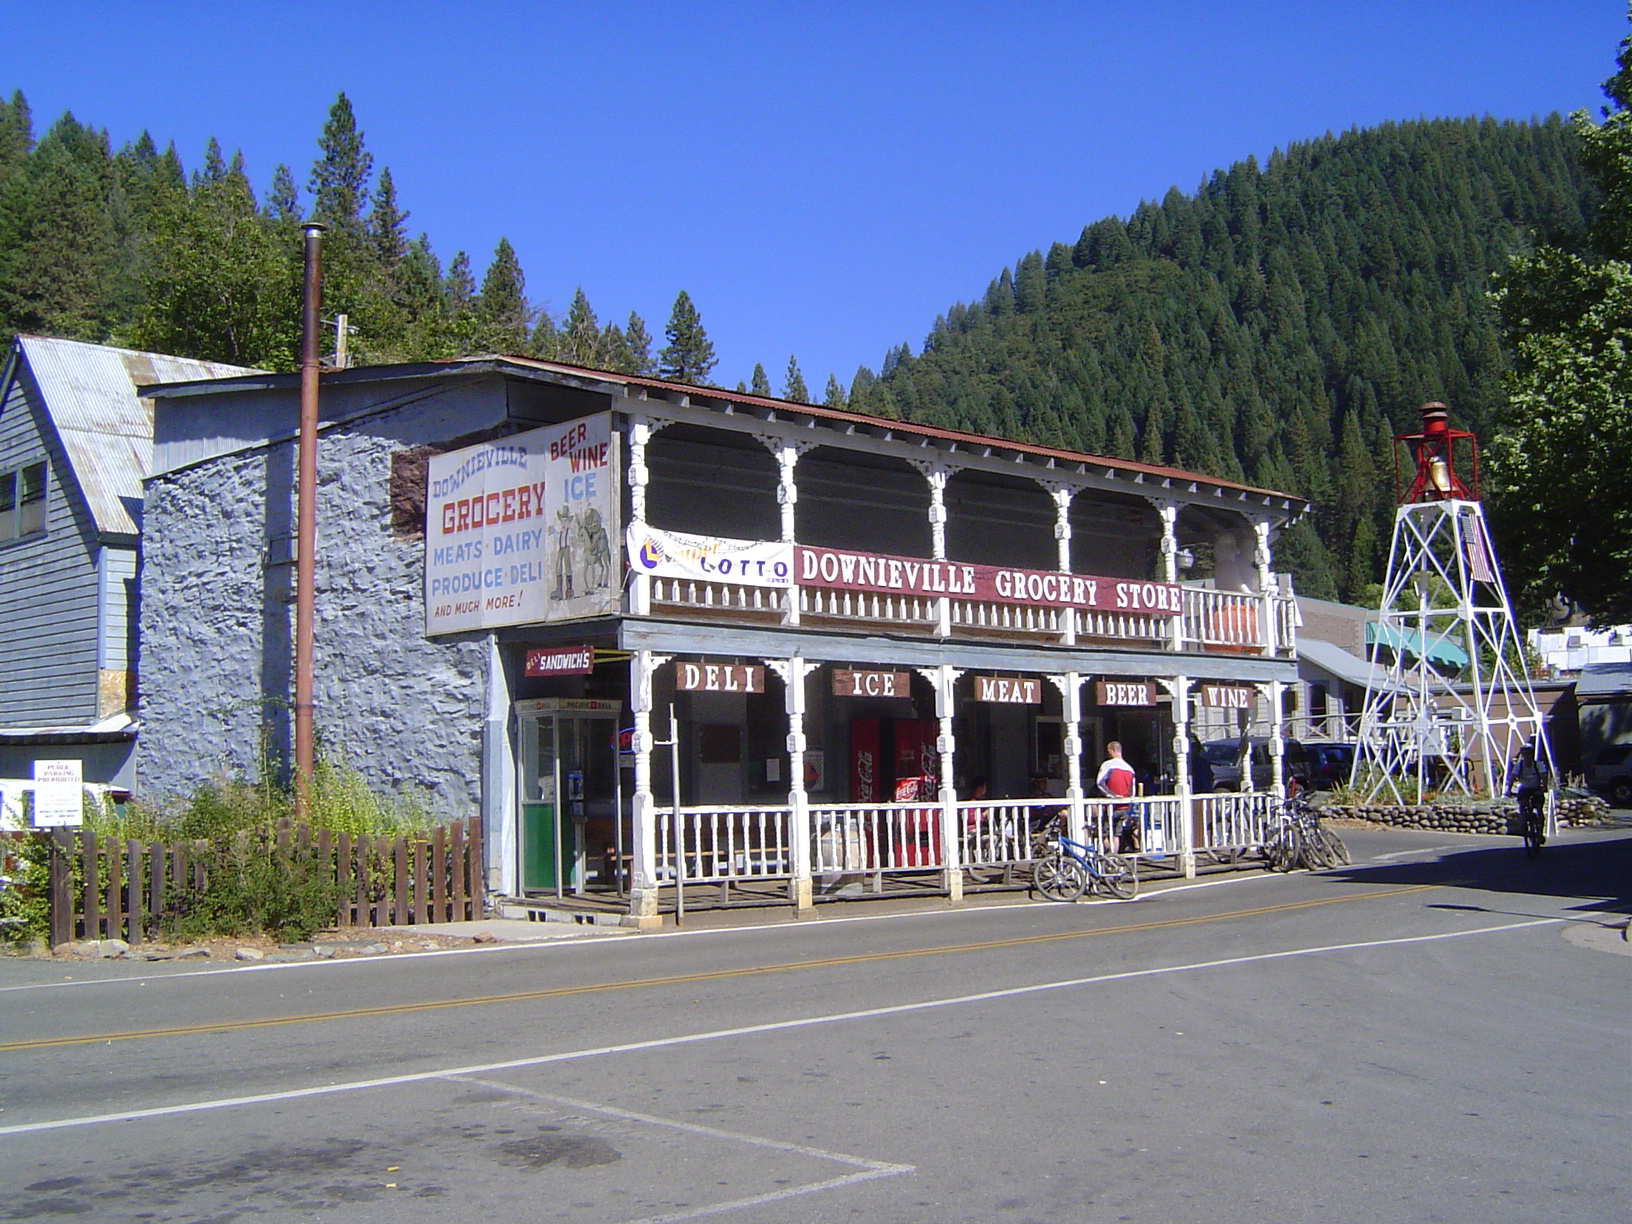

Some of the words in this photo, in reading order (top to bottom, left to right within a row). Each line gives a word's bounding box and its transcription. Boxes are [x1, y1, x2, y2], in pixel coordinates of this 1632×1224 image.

[551, 423, 587, 461] BEER
[569, 442, 608, 473] WINE
[433, 446, 528, 498] DOWNIEVILLE
[564, 472, 597, 503] ICE
[443, 481, 546, 534] GROCERY
[433, 540, 482, 567] MEATS
[494, 528, 543, 556] DAIRY
[432, 568, 502, 596] PRODUCE
[510, 561, 542, 584] DELI
[700, 556, 788, 577] LOTTO
[802, 550, 976, 594] DOWNIEVILLE
[995, 570, 1097, 606] GROCERY
[1116, 583, 1181, 612] STORE
[435, 604, 452, 618] AND
[455, 600, 480, 615] MUCH
[685, 664, 754, 692] DELI
[853, 672, 895, 696] ICE
[981, 679, 1034, 704] MEAT
[1105, 683, 1149, 706] BEER
[1207, 687, 1248, 709] WINE
